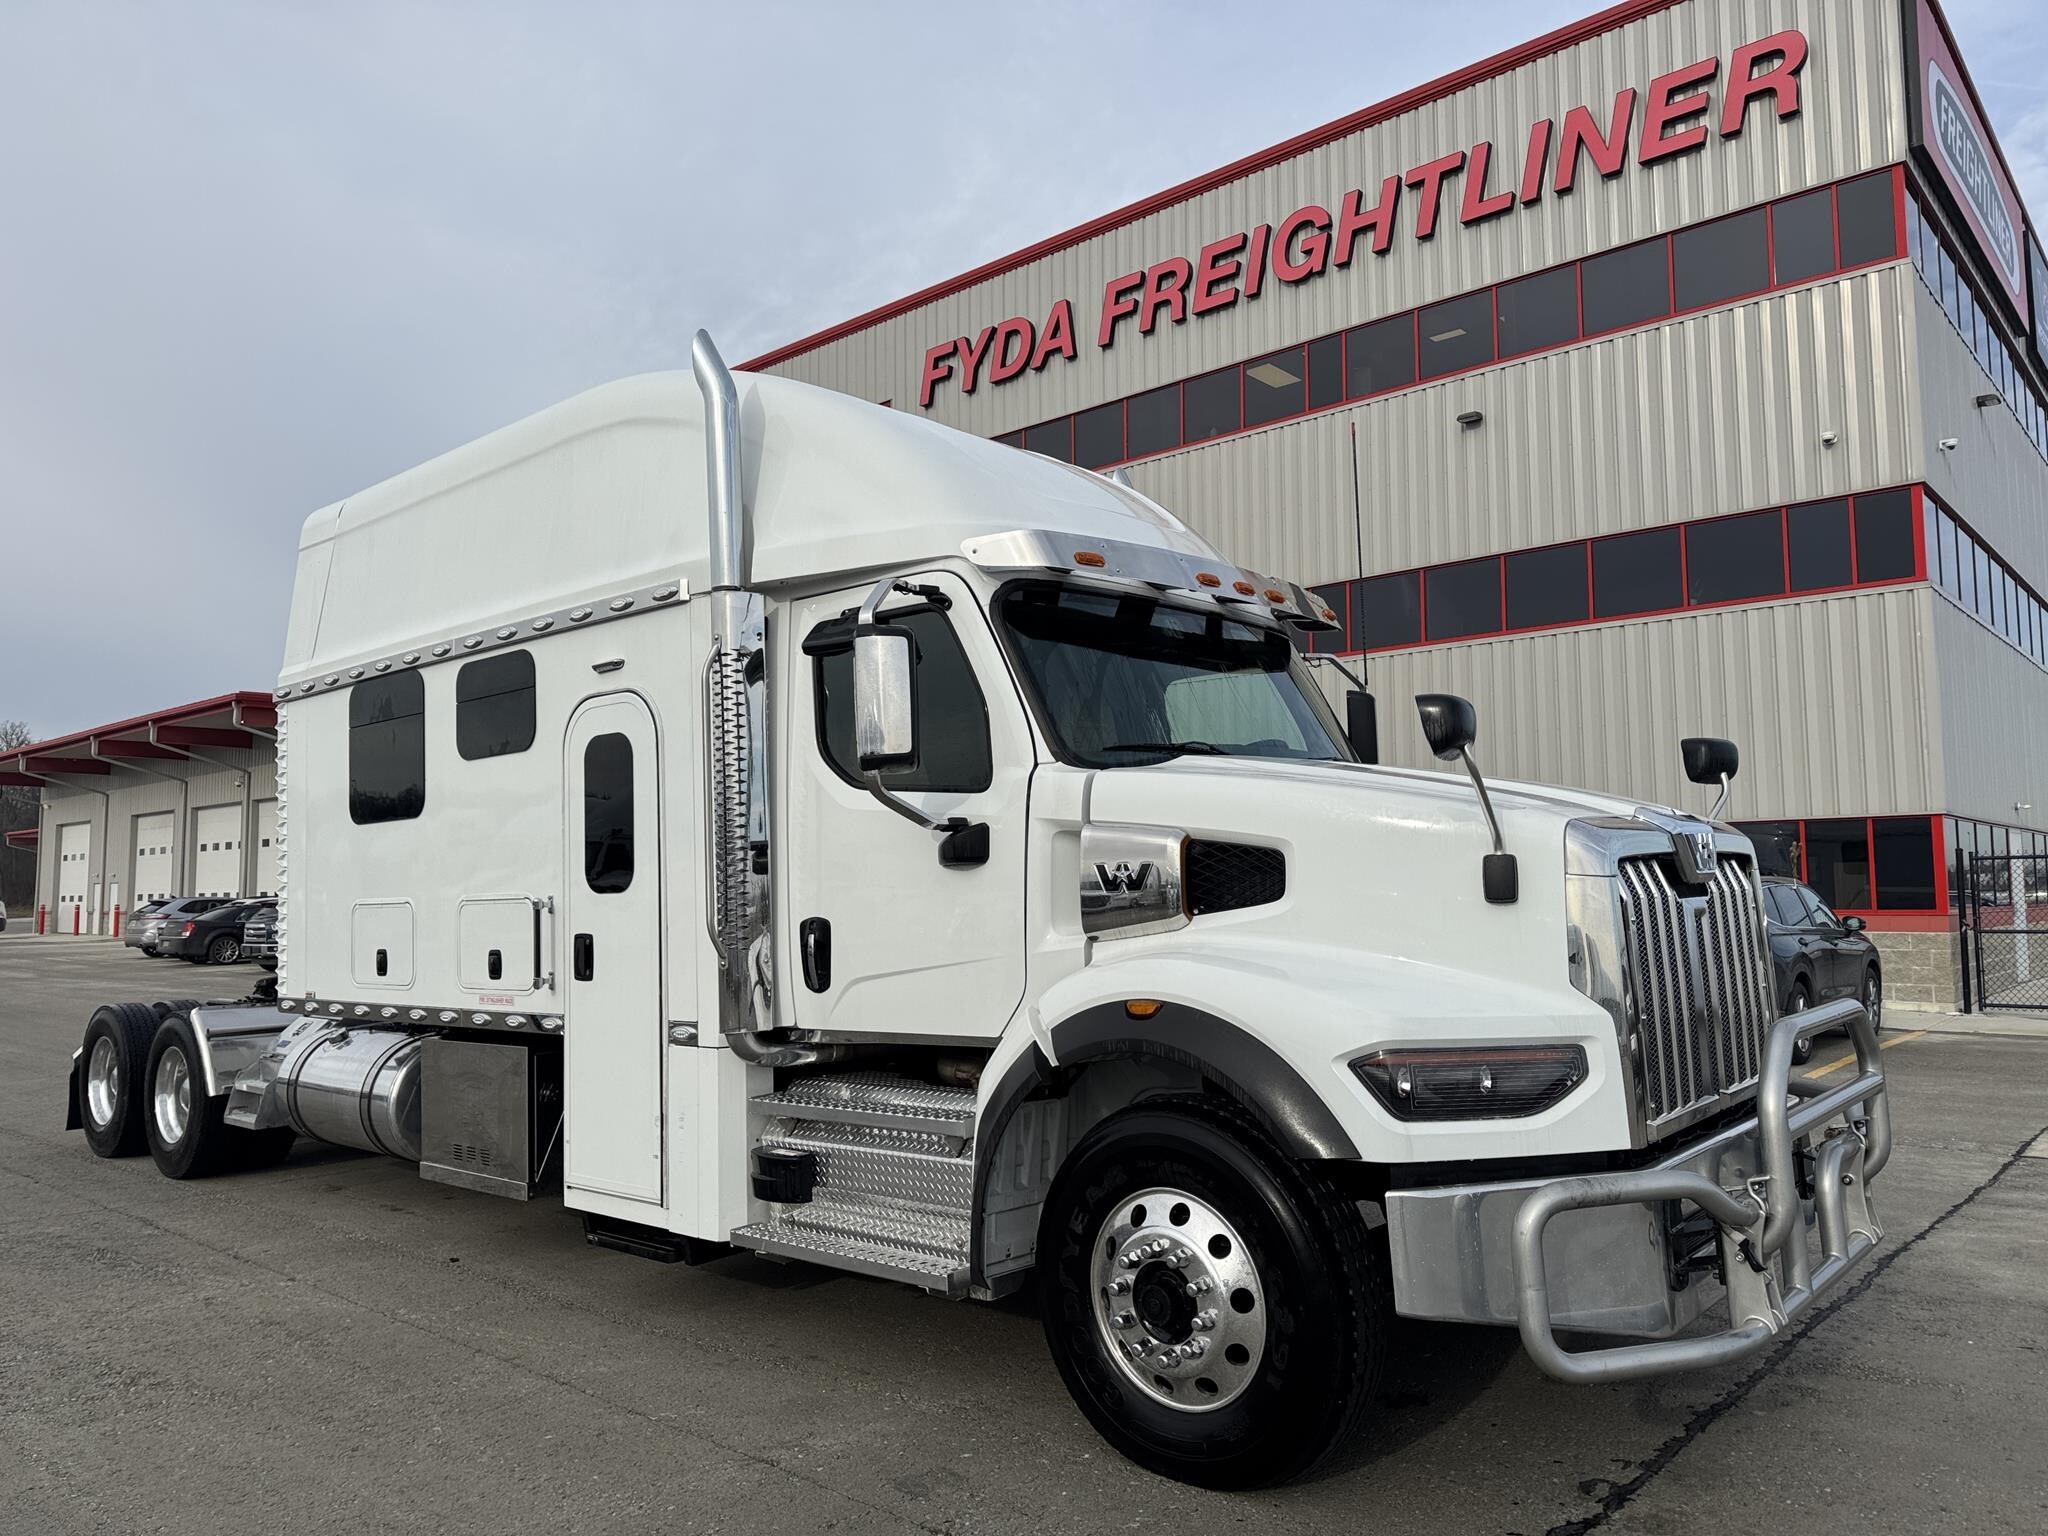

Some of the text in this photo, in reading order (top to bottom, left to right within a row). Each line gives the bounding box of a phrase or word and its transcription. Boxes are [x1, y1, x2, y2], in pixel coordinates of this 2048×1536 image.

[920, 29, 1808, 408] FYDA FREIGHTLINER
[1940, 92, 2013, 266] FREIGHTLINER
